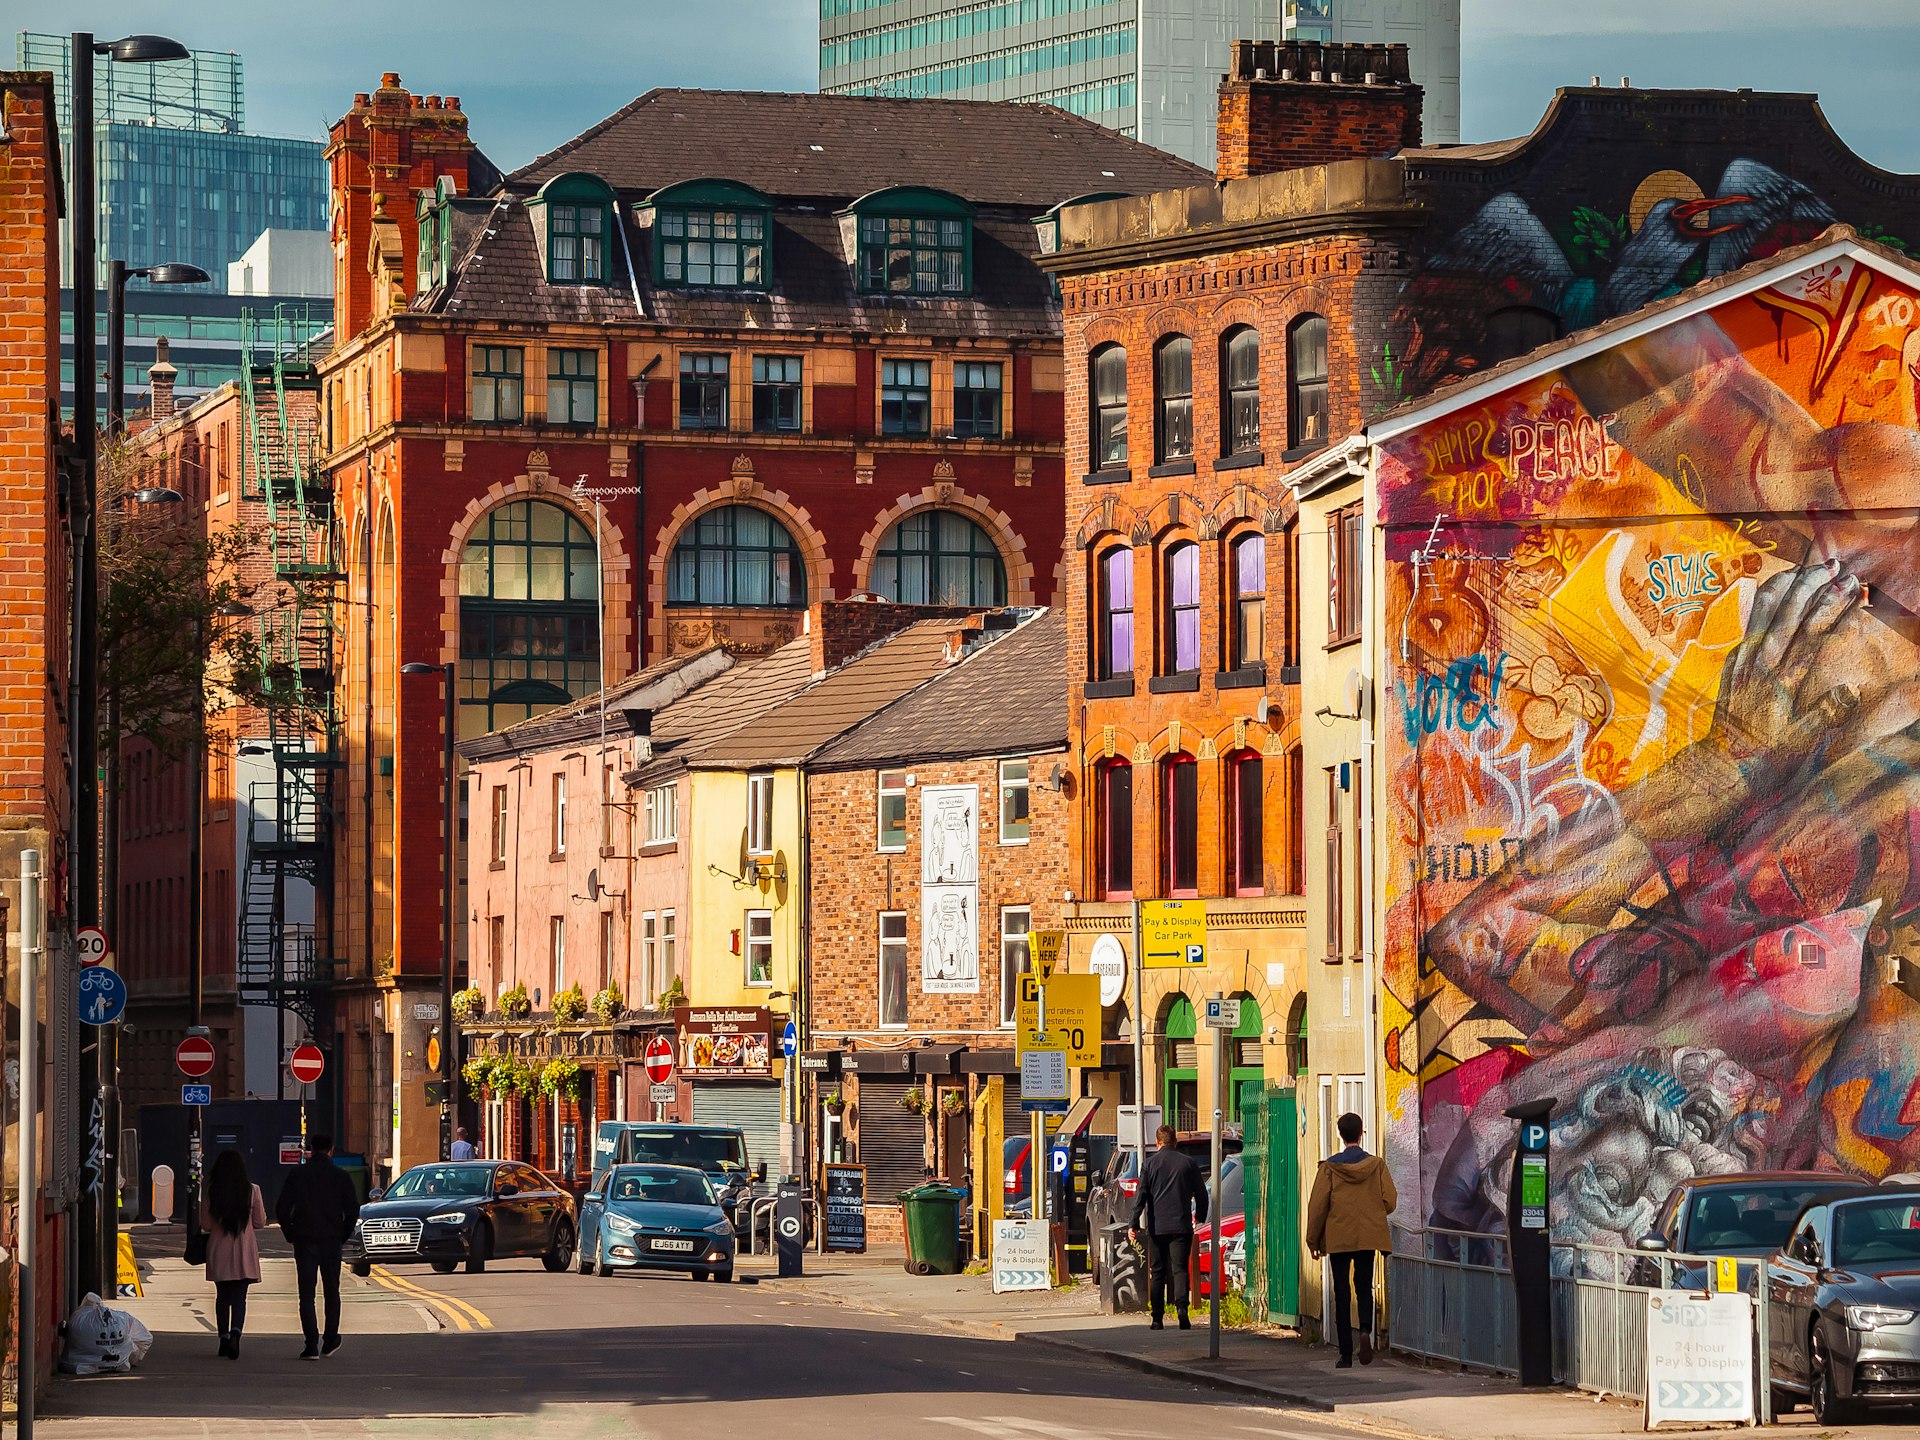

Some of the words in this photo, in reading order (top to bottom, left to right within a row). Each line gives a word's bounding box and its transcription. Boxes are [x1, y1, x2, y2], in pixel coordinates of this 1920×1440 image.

[1508, 413, 1620, 484] PEACE
[1648, 551, 1723, 602] STYLE
[1145, 918, 1160, 927] Pay
[1171, 918, 1201, 926] Display
[79, 938, 104, 953] 20
[1042, 936, 1056, 947] PAY
[1039, 950, 1057, 961] HERE
[801, 1056, 827, 1068] Entrance
[1530, 1126, 1544, 1148] P
[828, 1215, 862, 1225] PIZZA
[828, 1225, 846, 1233] CRAFT
[676, 1241, 689, 1249] AYY
[1675, 1341, 1691, 1352] 24
[1695, 1341, 1726, 1352] hour
[1655, 1356, 1679, 1368] Pay
[1683, 1356, 1694, 1368] &
[1698, 1356, 1746, 1369] Display
